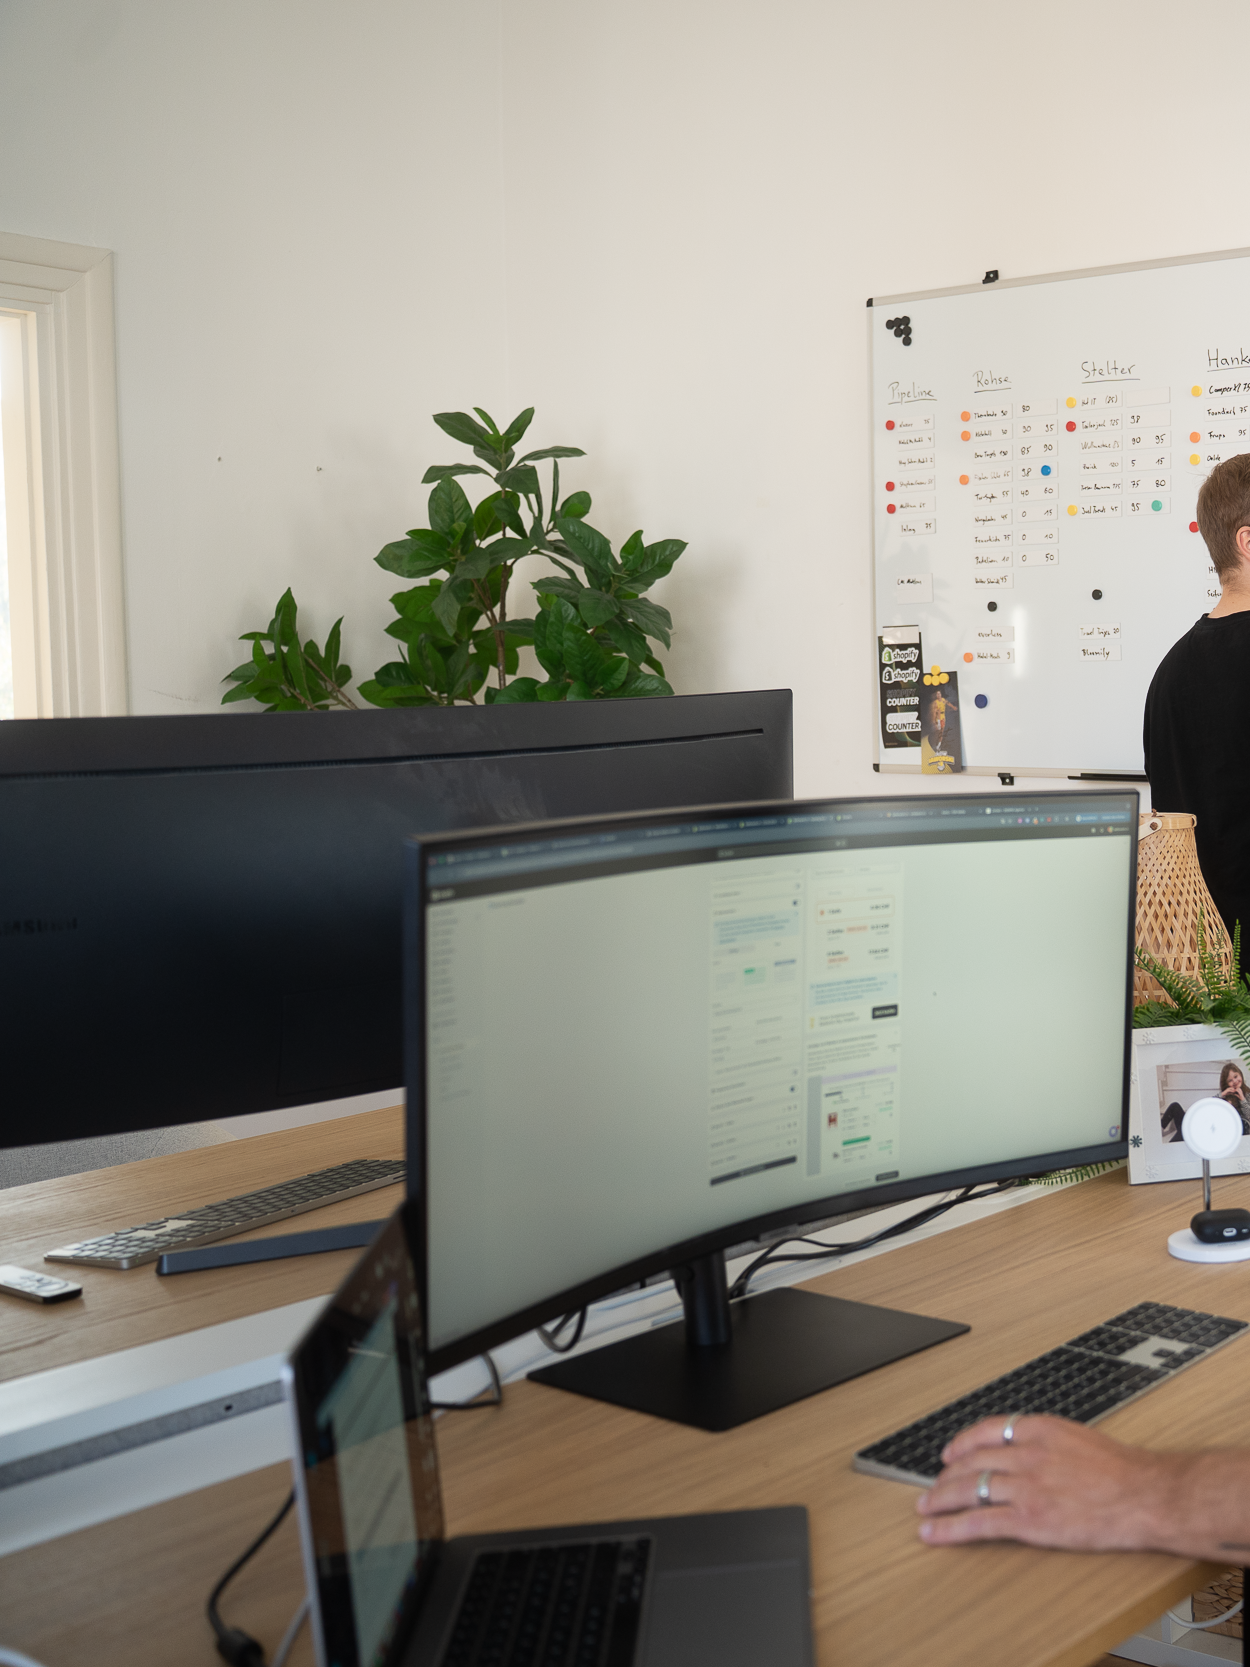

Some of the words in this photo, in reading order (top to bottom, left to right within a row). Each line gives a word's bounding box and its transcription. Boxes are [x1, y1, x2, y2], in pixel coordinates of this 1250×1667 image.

[1081, 360, 1136, 379] Stelter
[972, 370, 1012, 388] Rohse
[888, 382, 934, 405] Pipeline
[1155, 433, 1166, 444] 95
[1020, 445, 1032, 455] 85
[1043, 443, 1053, 452] 90
[1131, 459, 1136, 467] 5
[1155, 457, 1165, 465] 15
[1131, 479, 1141, 488] 75
[1155, 479, 1166, 487] 80
[1022, 554, 1027, 562] 0
[1045, 552, 1054, 562] 50
[893, 650, 918, 660] shopify
[893, 669, 919, 681] shopify
[886, 697, 919, 706] COUNTER
[888, 722, 920, 731] COUNTER
